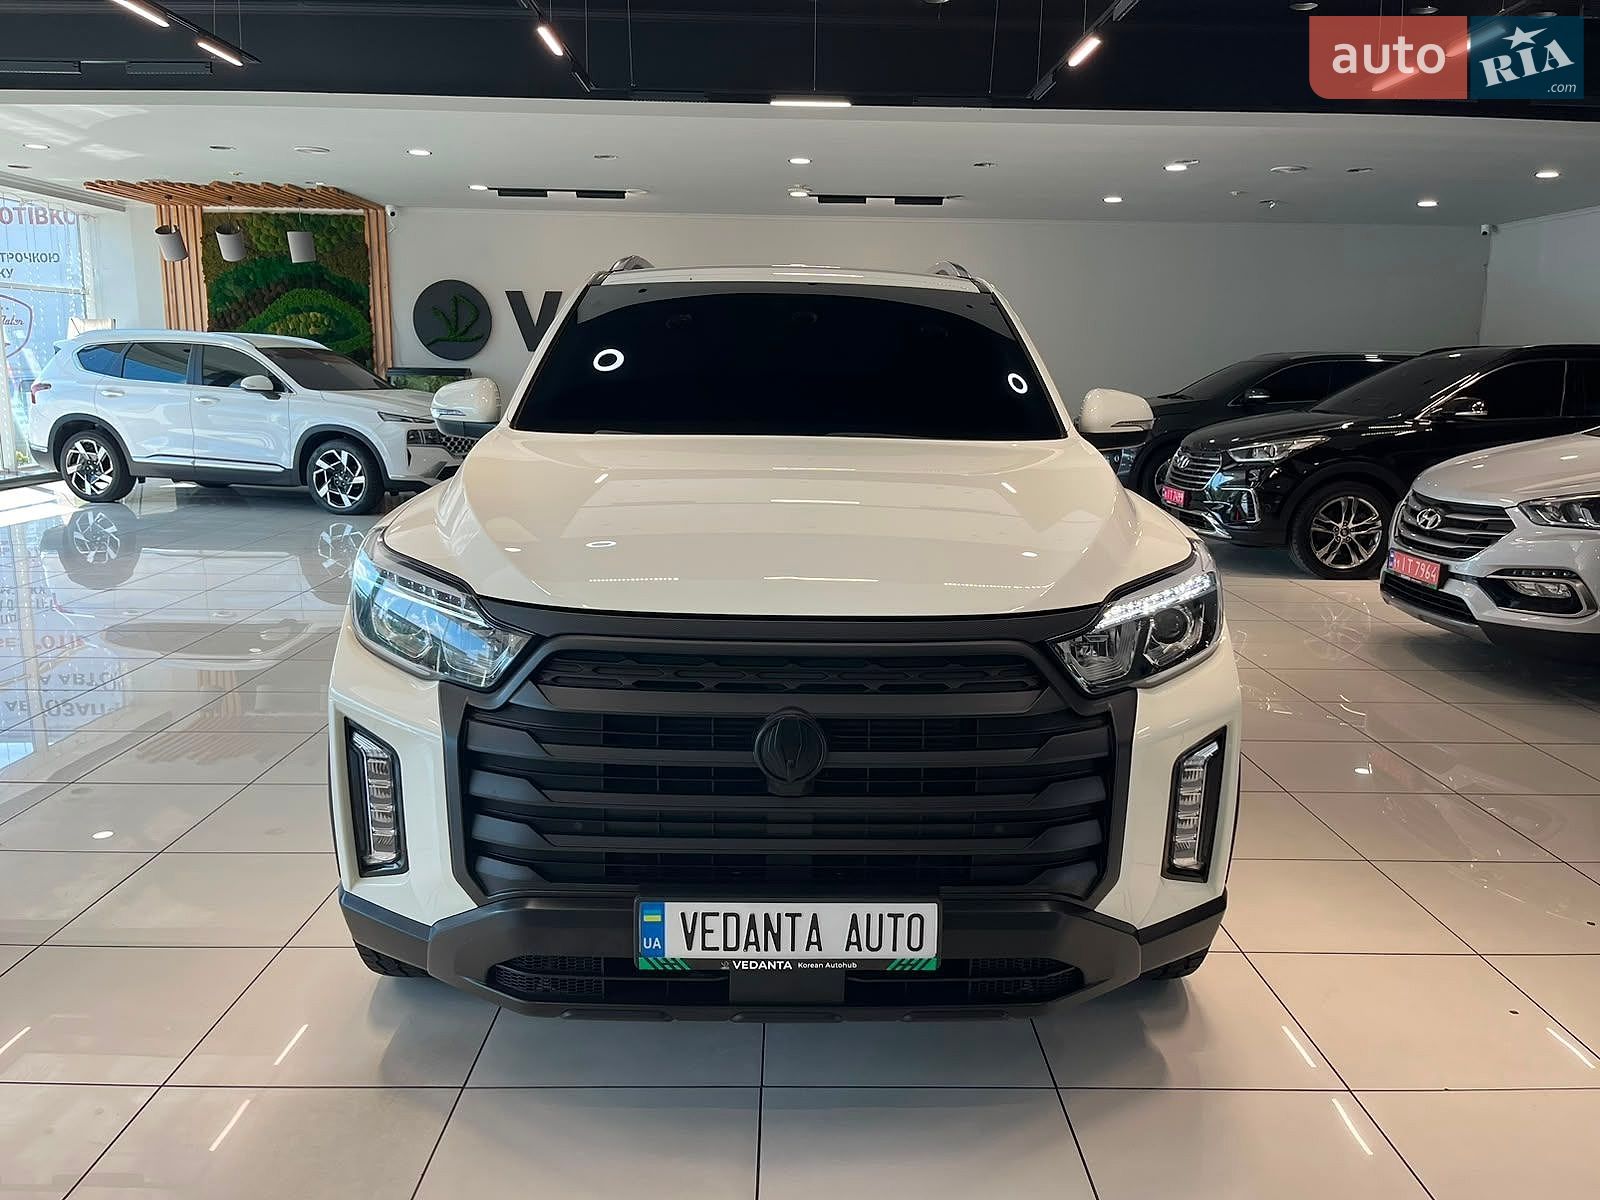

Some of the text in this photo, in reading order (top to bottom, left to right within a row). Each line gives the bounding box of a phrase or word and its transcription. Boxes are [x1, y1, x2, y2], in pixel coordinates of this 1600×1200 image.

[680, 911, 925, 952] VEDANTA AUTO
[643, 937, 662, 950] UA
[732, 960, 793, 970] VEDANTA
[824, 961, 858, 970] Autohub
